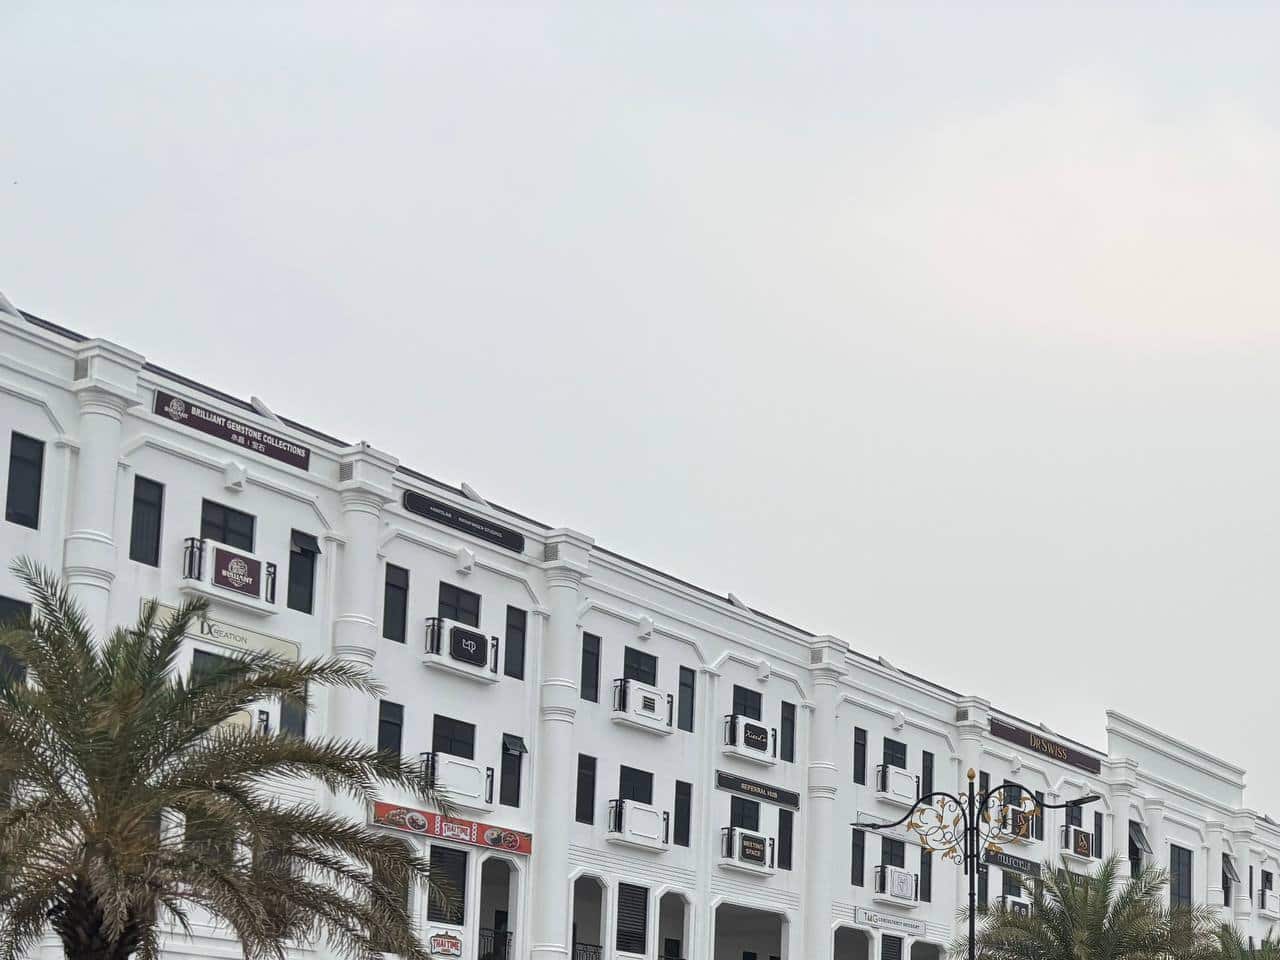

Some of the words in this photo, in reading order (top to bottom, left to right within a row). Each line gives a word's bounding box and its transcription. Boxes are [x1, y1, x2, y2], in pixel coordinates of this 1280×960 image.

[191, 405, 226, 427] BRILLIANT
[226, 420, 262, 440] GEMSTONE
[262, 434, 306, 458] COLLECTIONS
